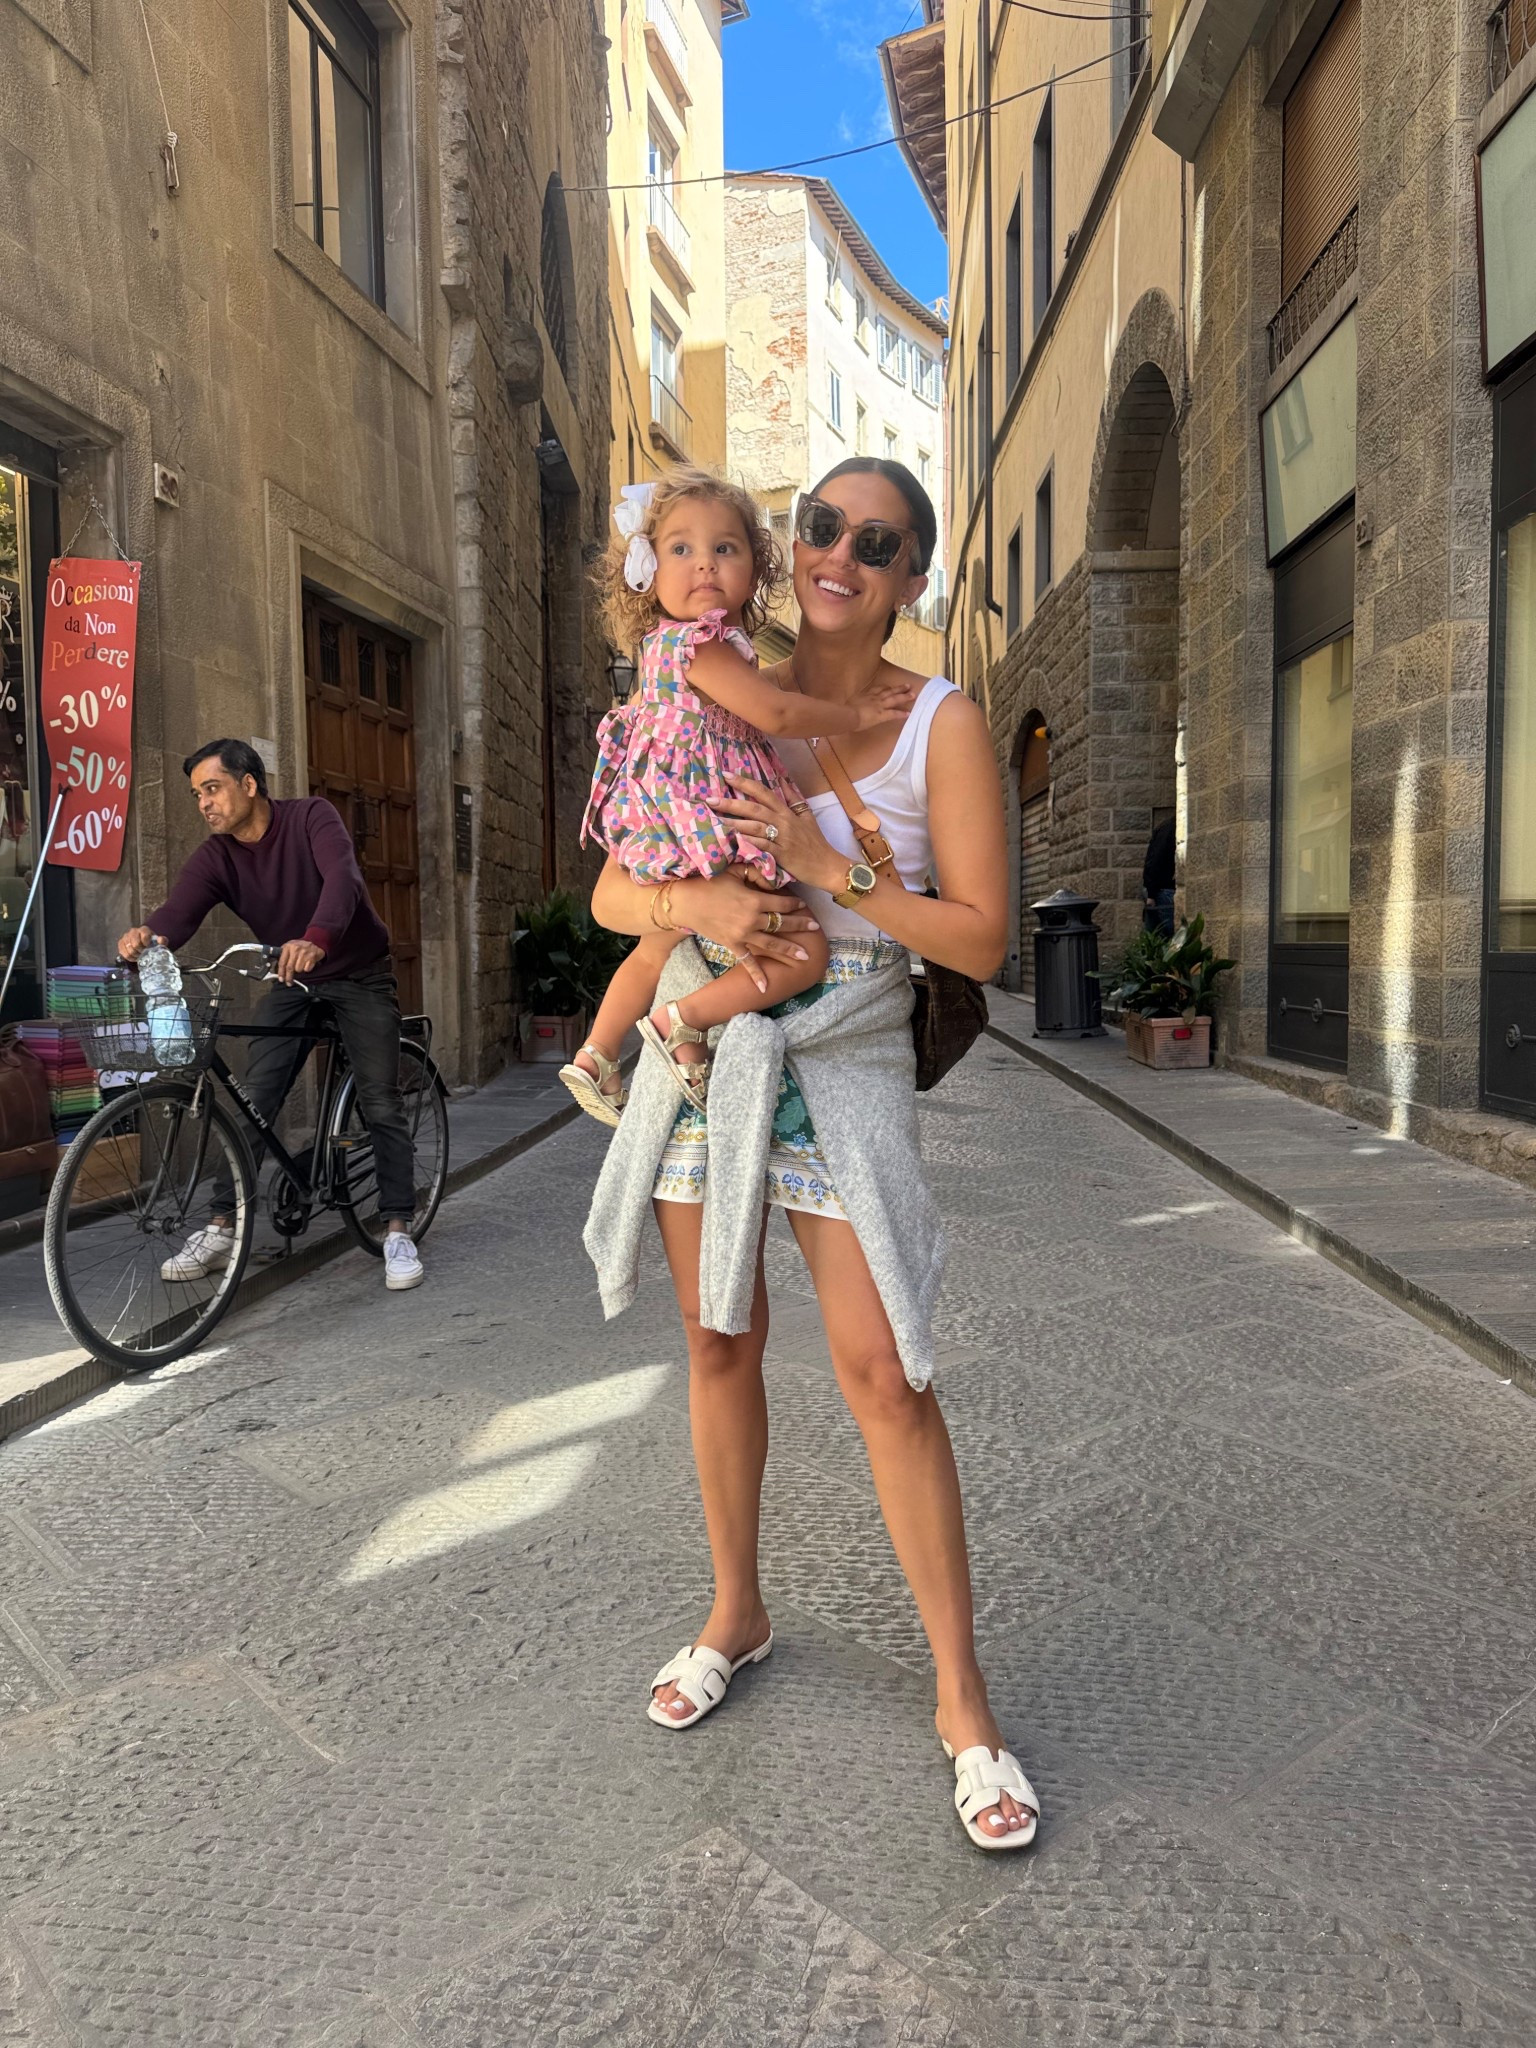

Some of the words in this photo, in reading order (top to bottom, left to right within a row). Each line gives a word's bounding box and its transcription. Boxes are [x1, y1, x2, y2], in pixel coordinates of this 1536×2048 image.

[51, 578, 133, 607] Occasioni
[64, 616, 80, 633] da
[84, 612, 117, 635] Non
[49, 640, 129, 671] Perdere
[50, 683, 127, 734] -30%
[56, 745, 126, 794] -50%
[54, 804, 122, 854] -60%
